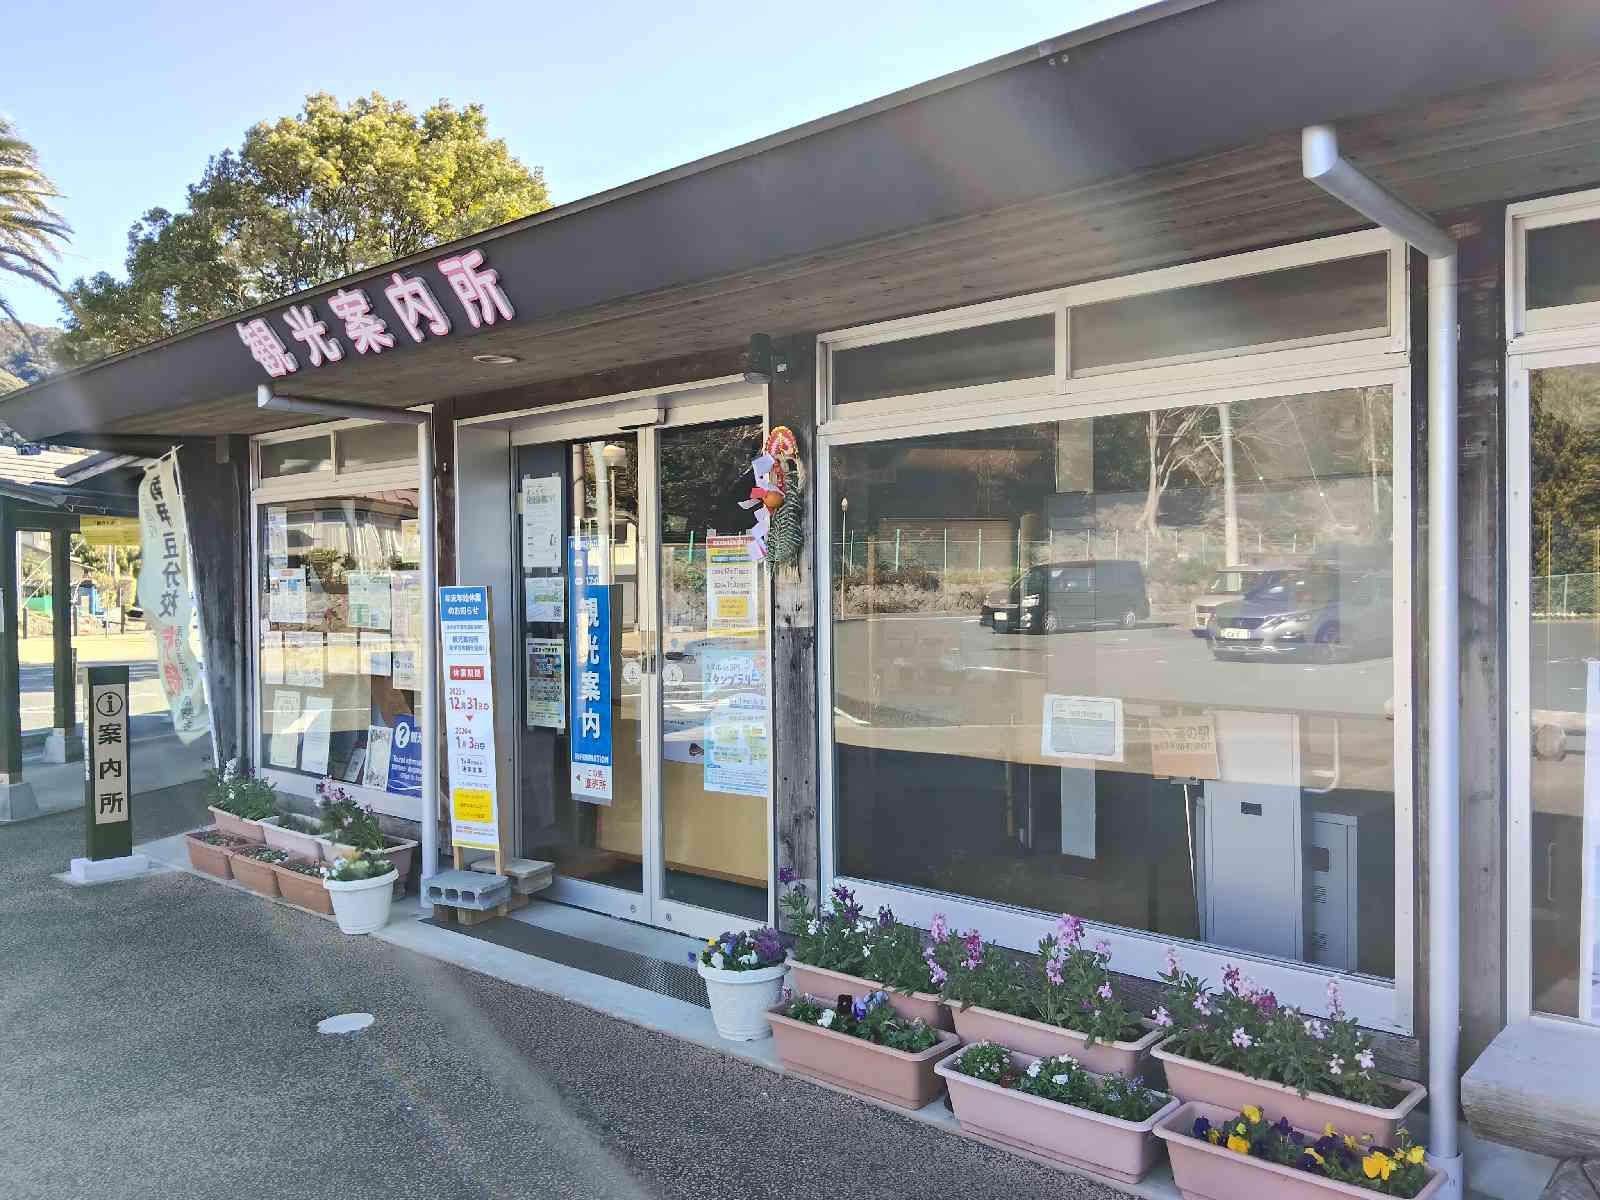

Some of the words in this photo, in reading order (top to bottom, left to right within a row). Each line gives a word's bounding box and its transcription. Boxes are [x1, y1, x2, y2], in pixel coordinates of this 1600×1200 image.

[235, 248, 515, 379] 観光案内所
[447, 605, 480, 616] のお知らせ
[97, 722, 124, 815] 案内所
